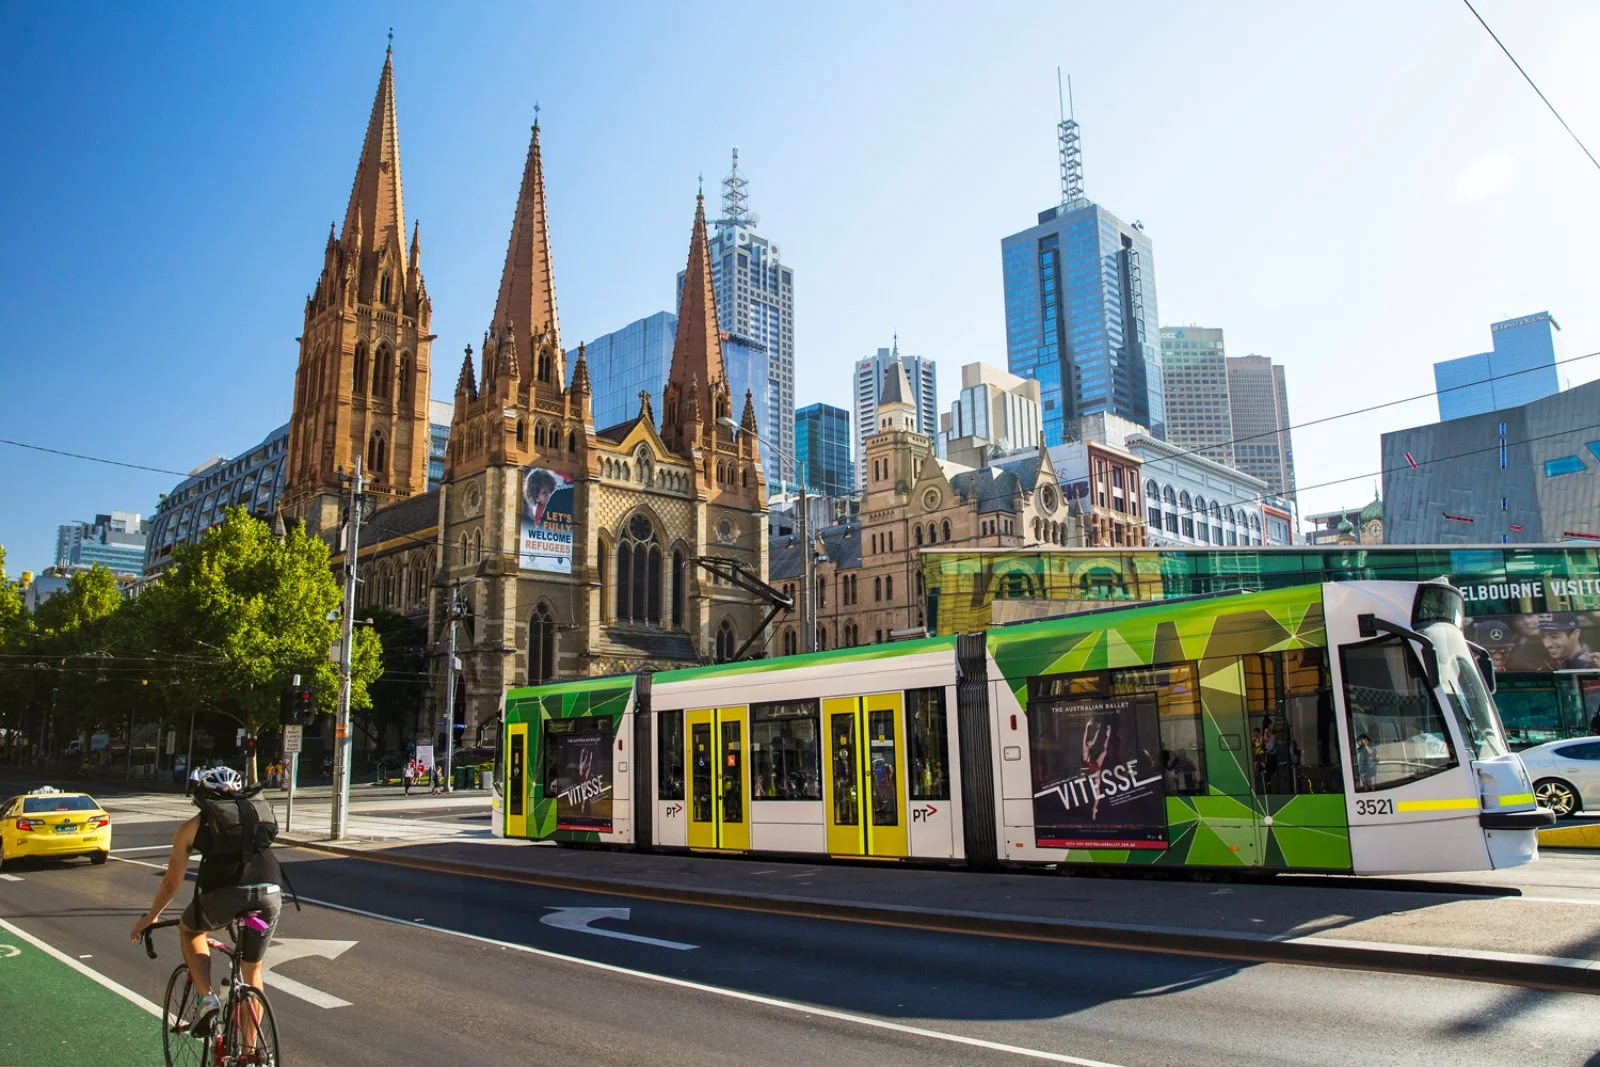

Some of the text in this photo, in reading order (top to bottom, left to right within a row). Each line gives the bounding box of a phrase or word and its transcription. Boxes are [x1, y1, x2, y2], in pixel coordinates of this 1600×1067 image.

[546, 511, 572, 523] LET'S
[543, 520, 572, 533] FULLY
[528, 529, 571, 543] WELCOME
[525, 539, 571, 554] REFUGEES
[1459, 582, 1543, 601] ELBOURNE
[1065, 704, 1104, 712] AUSTRALIAN
[1105, 702, 1129, 710] BALLET
[557, 775, 612, 807] VITESSE
[1034, 759, 1162, 810] VITESSE
[1355, 798, 1393, 815] 3521
